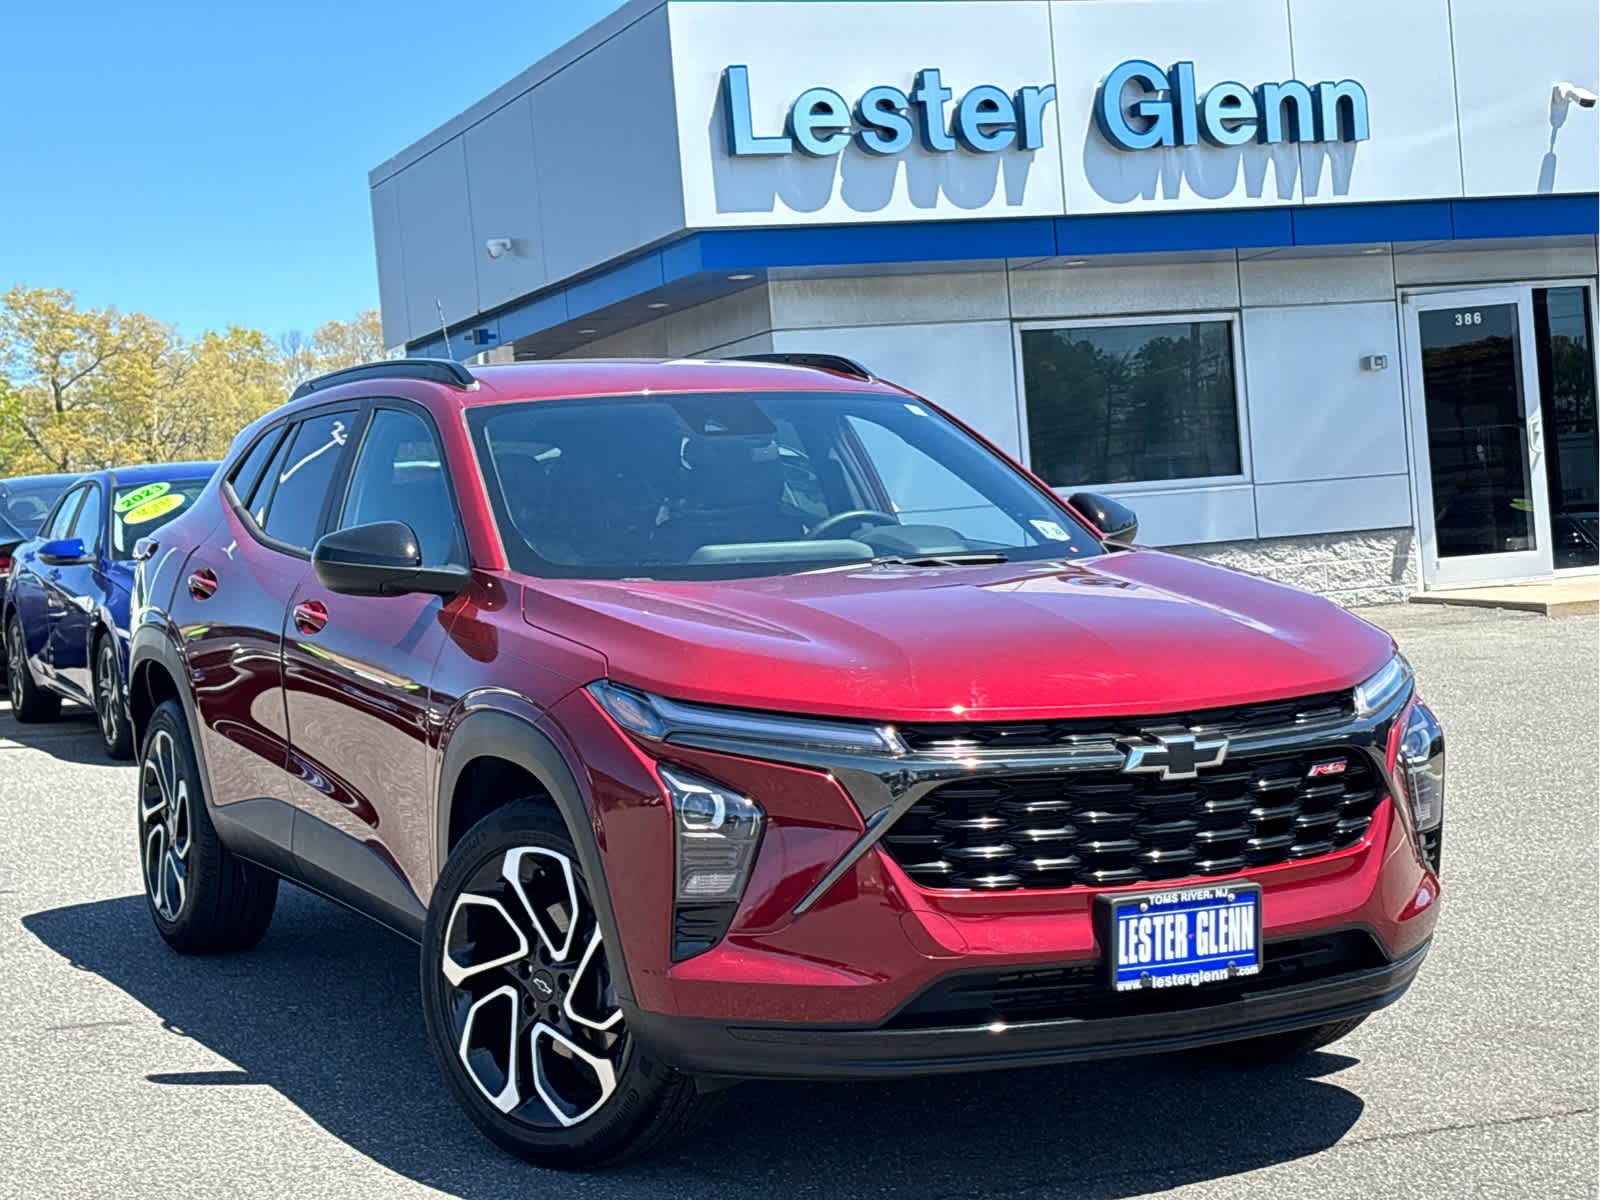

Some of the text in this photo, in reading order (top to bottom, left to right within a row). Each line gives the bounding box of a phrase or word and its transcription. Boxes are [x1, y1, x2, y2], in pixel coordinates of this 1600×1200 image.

[720, 58, 1370, 158] Lester Glenn
[1455, 312, 1482, 326] 386
[121, 484, 164, 508] 2023
[1308, 760, 1347, 776] RS
[1149, 893, 1179, 905] TOMS
[1215, 888, 1228, 899] NJ
[1118, 905, 1254, 965] LESTER GLENN
